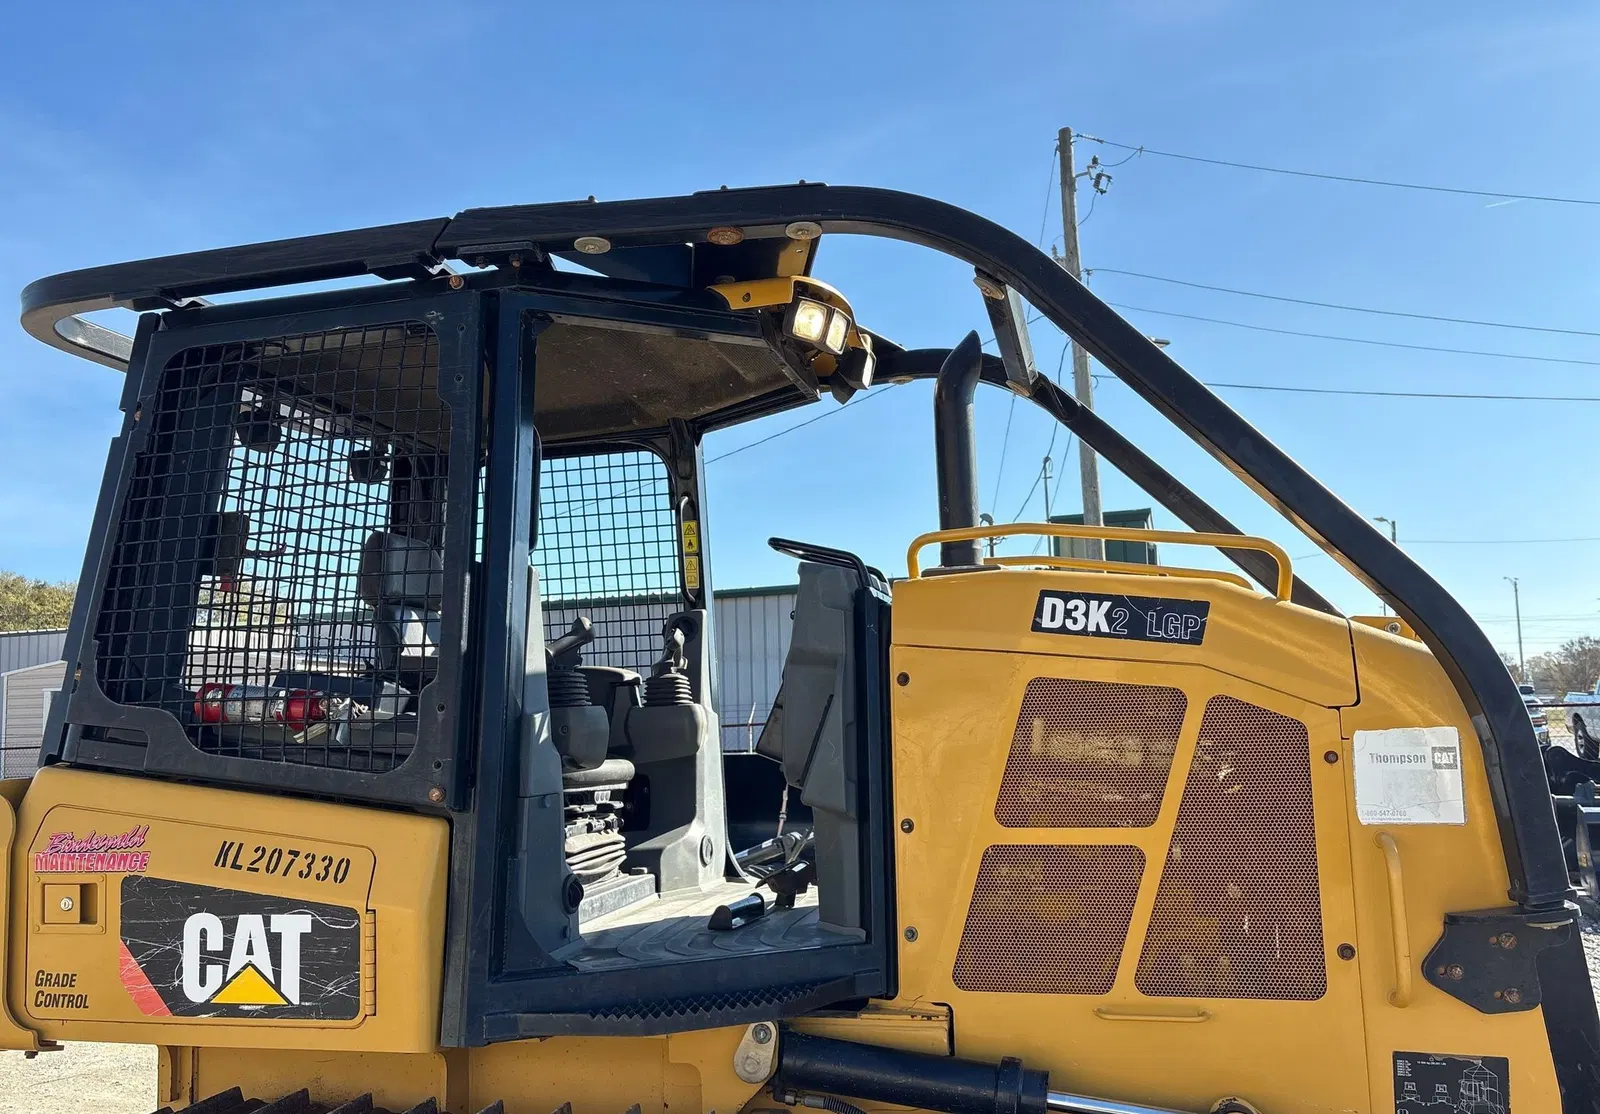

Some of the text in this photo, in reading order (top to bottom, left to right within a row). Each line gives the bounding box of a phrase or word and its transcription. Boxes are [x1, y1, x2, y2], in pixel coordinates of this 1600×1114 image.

[1041, 597, 1201, 640] D3K2 LGP
[1369, 751, 1456, 765] Thompson CAT
[34, 851, 150, 872] MAINTENANCE
[214, 840, 351, 884] KL207330
[182, 912, 312, 1005] CAT
[35, 969, 78, 988] GRADE
[34, 990, 90, 1009] CONTROL
